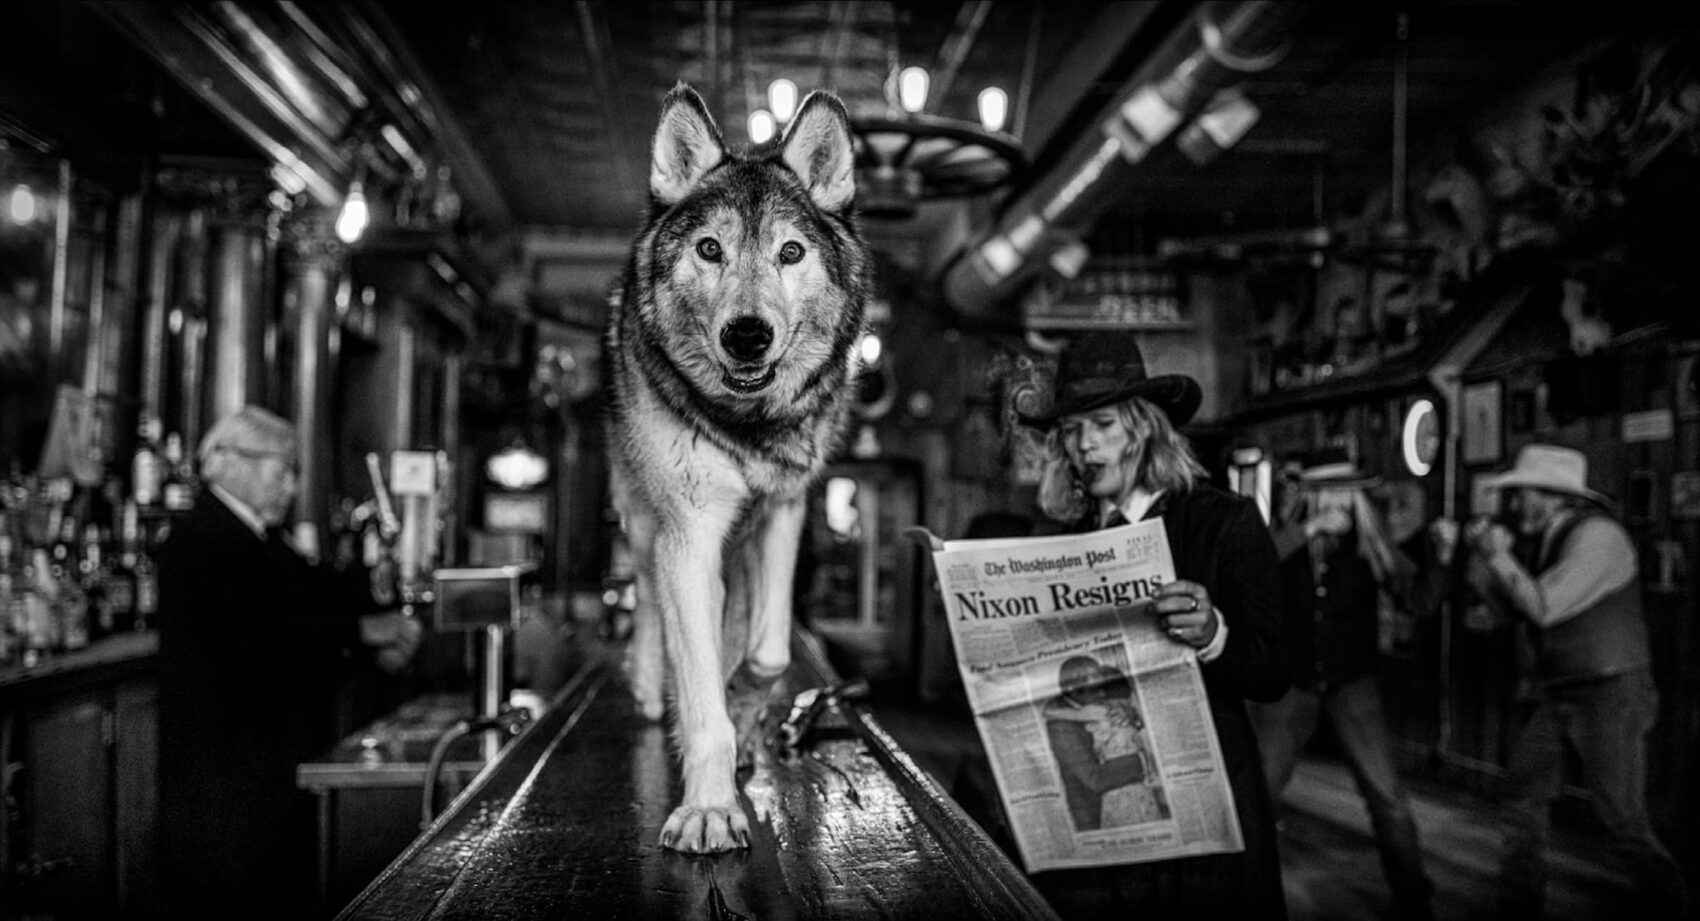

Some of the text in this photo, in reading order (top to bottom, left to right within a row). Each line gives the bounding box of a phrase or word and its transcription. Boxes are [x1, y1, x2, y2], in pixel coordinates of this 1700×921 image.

[984, 561, 1006, 577] The
[1008, 557, 1083, 574] Washington
[1085, 547, 1116, 569] Post
[954, 574, 1162, 621] Nixon Resigns
